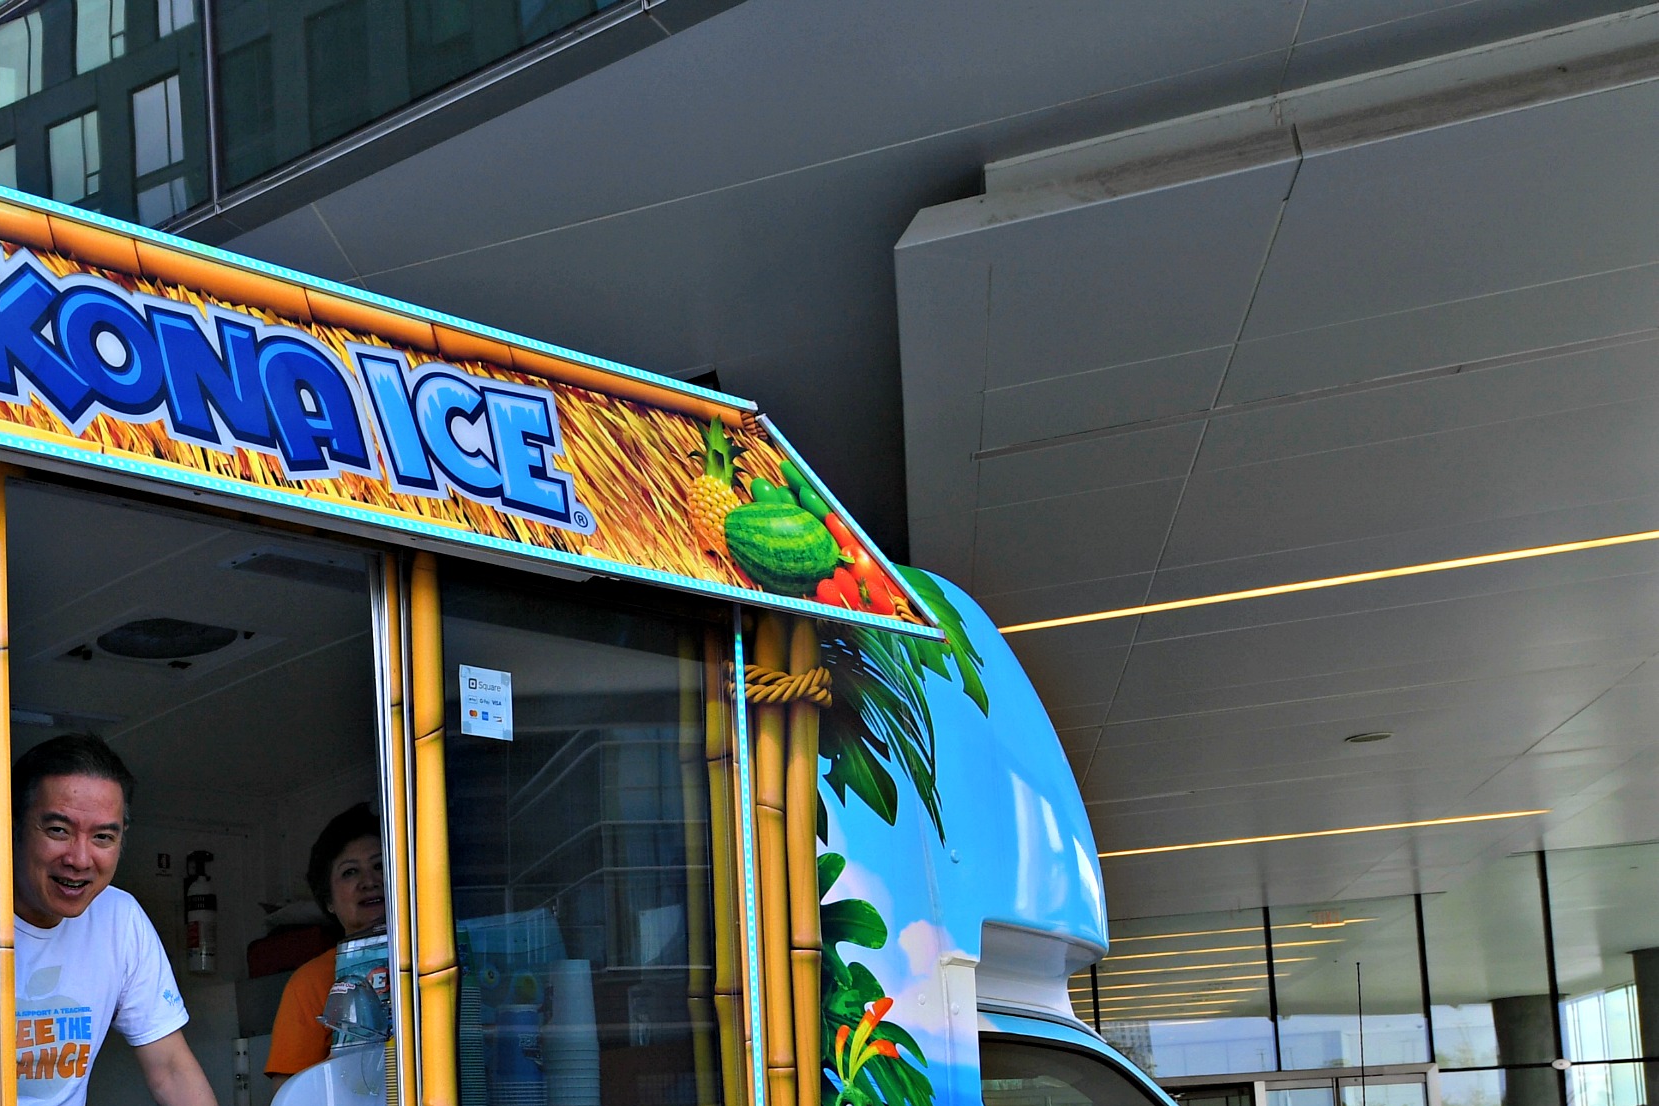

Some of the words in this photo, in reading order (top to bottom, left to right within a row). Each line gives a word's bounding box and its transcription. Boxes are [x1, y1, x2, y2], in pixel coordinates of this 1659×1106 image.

[351, 347, 573, 527] ICE
[478, 681, 501, 692] Square
[56, 1016, 91, 1041] THE
